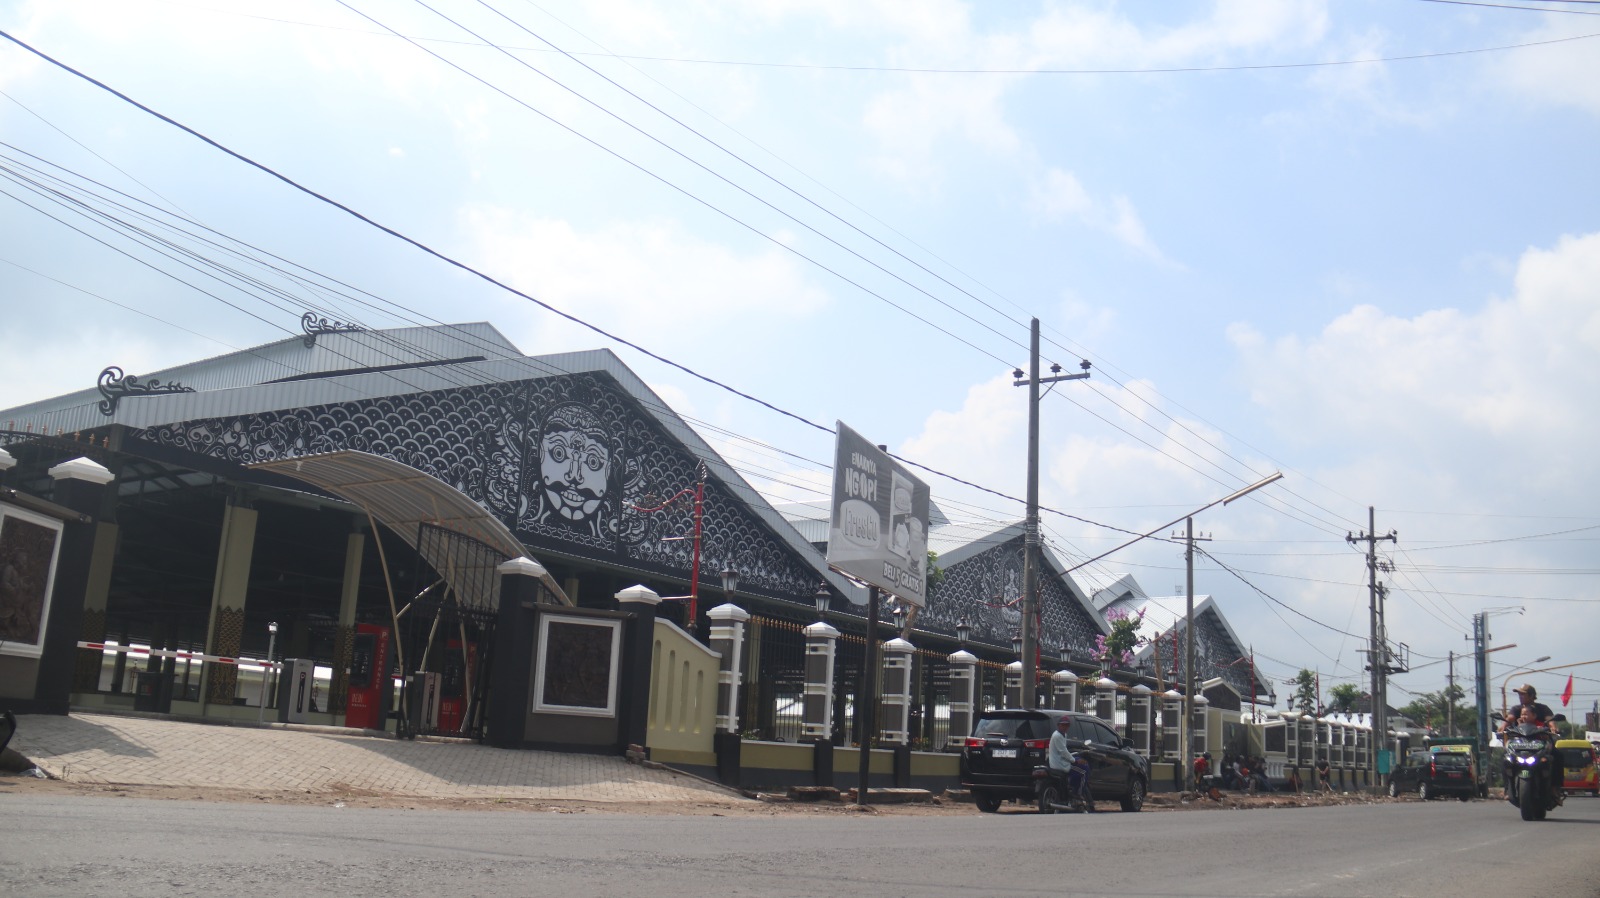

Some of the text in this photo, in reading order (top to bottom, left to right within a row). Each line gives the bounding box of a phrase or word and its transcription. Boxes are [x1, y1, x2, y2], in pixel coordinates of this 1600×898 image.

[845, 468, 878, 502] NGOPI
[883, 562, 896, 581] BELI
[895, 567, 901, 588] 5
[901, 571, 919, 593] GRATIS
[376, 643, 384, 689] ENTRANCE
